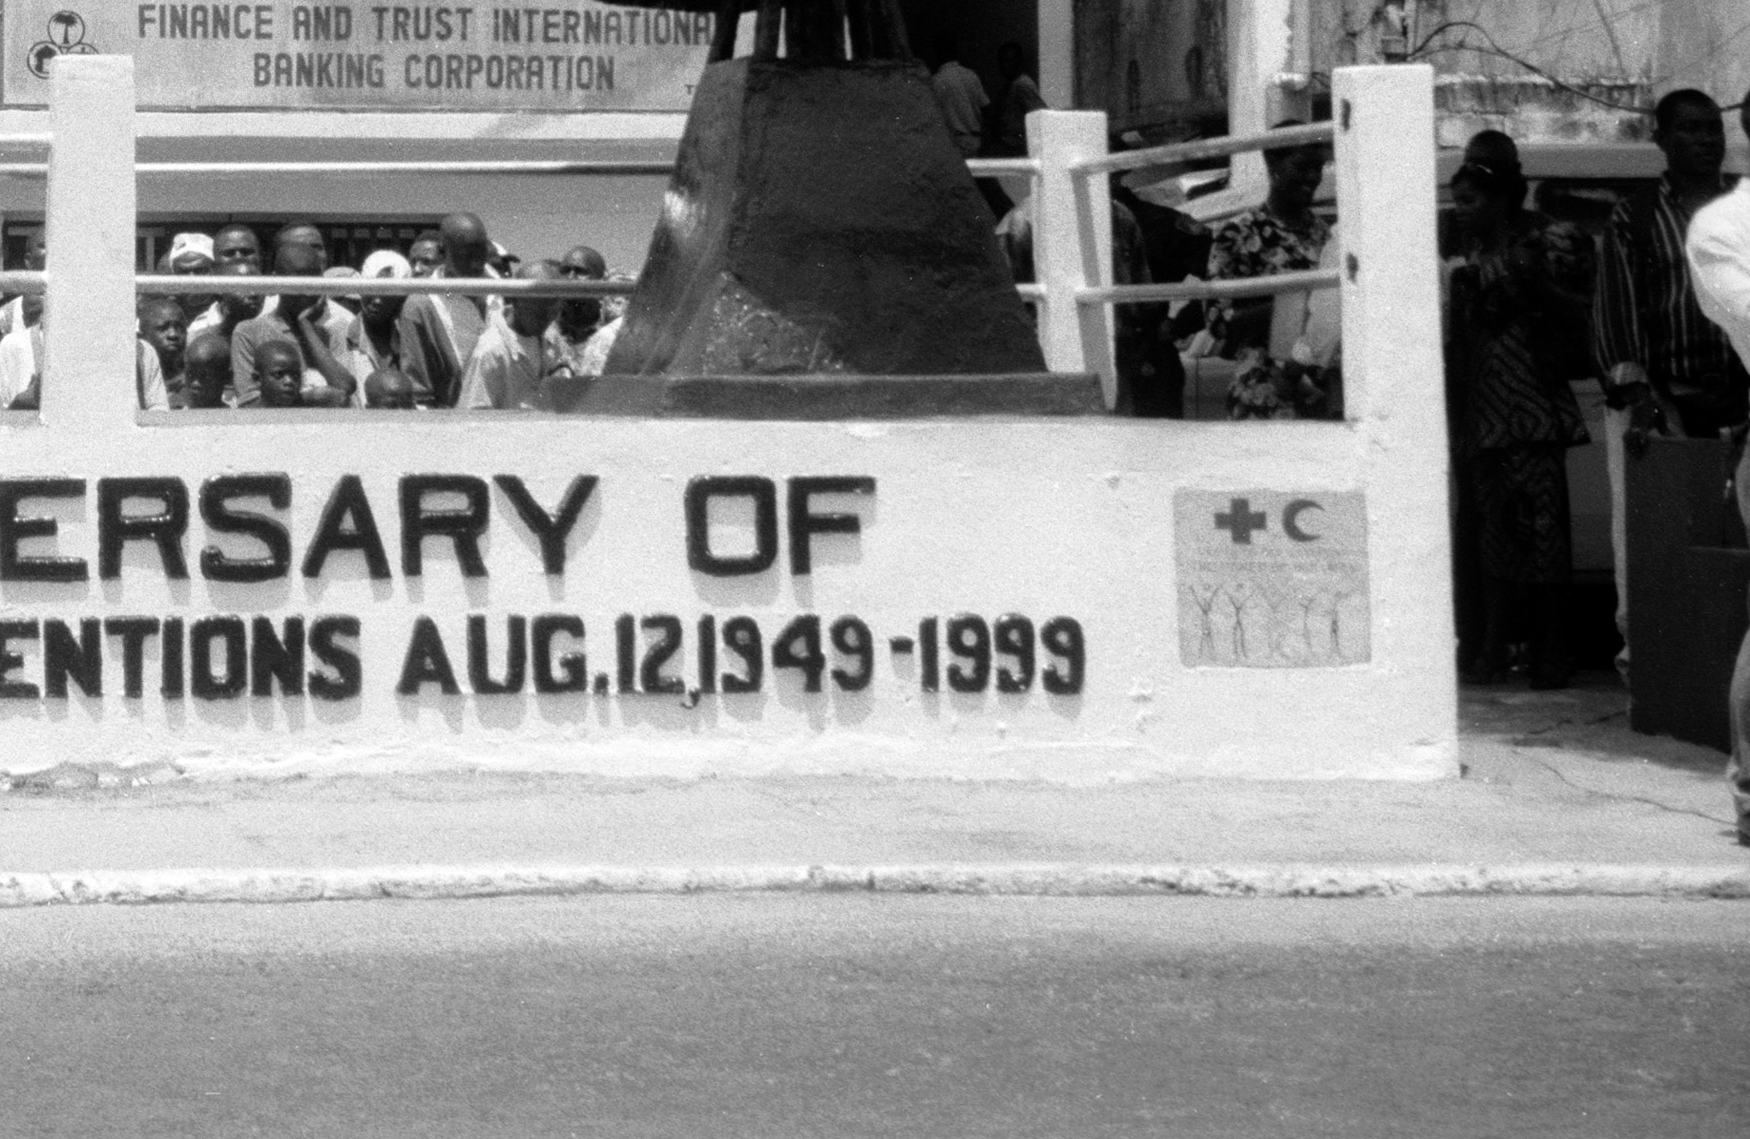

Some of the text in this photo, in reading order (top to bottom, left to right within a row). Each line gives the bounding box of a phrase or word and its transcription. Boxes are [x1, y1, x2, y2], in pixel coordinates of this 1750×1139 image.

[137, 3, 713, 46] FINANCE AND TRUST INTERNATIONA
[252, 53, 615, 91] BANKING CORPORATION
[683, 475, 878, 577] OF
